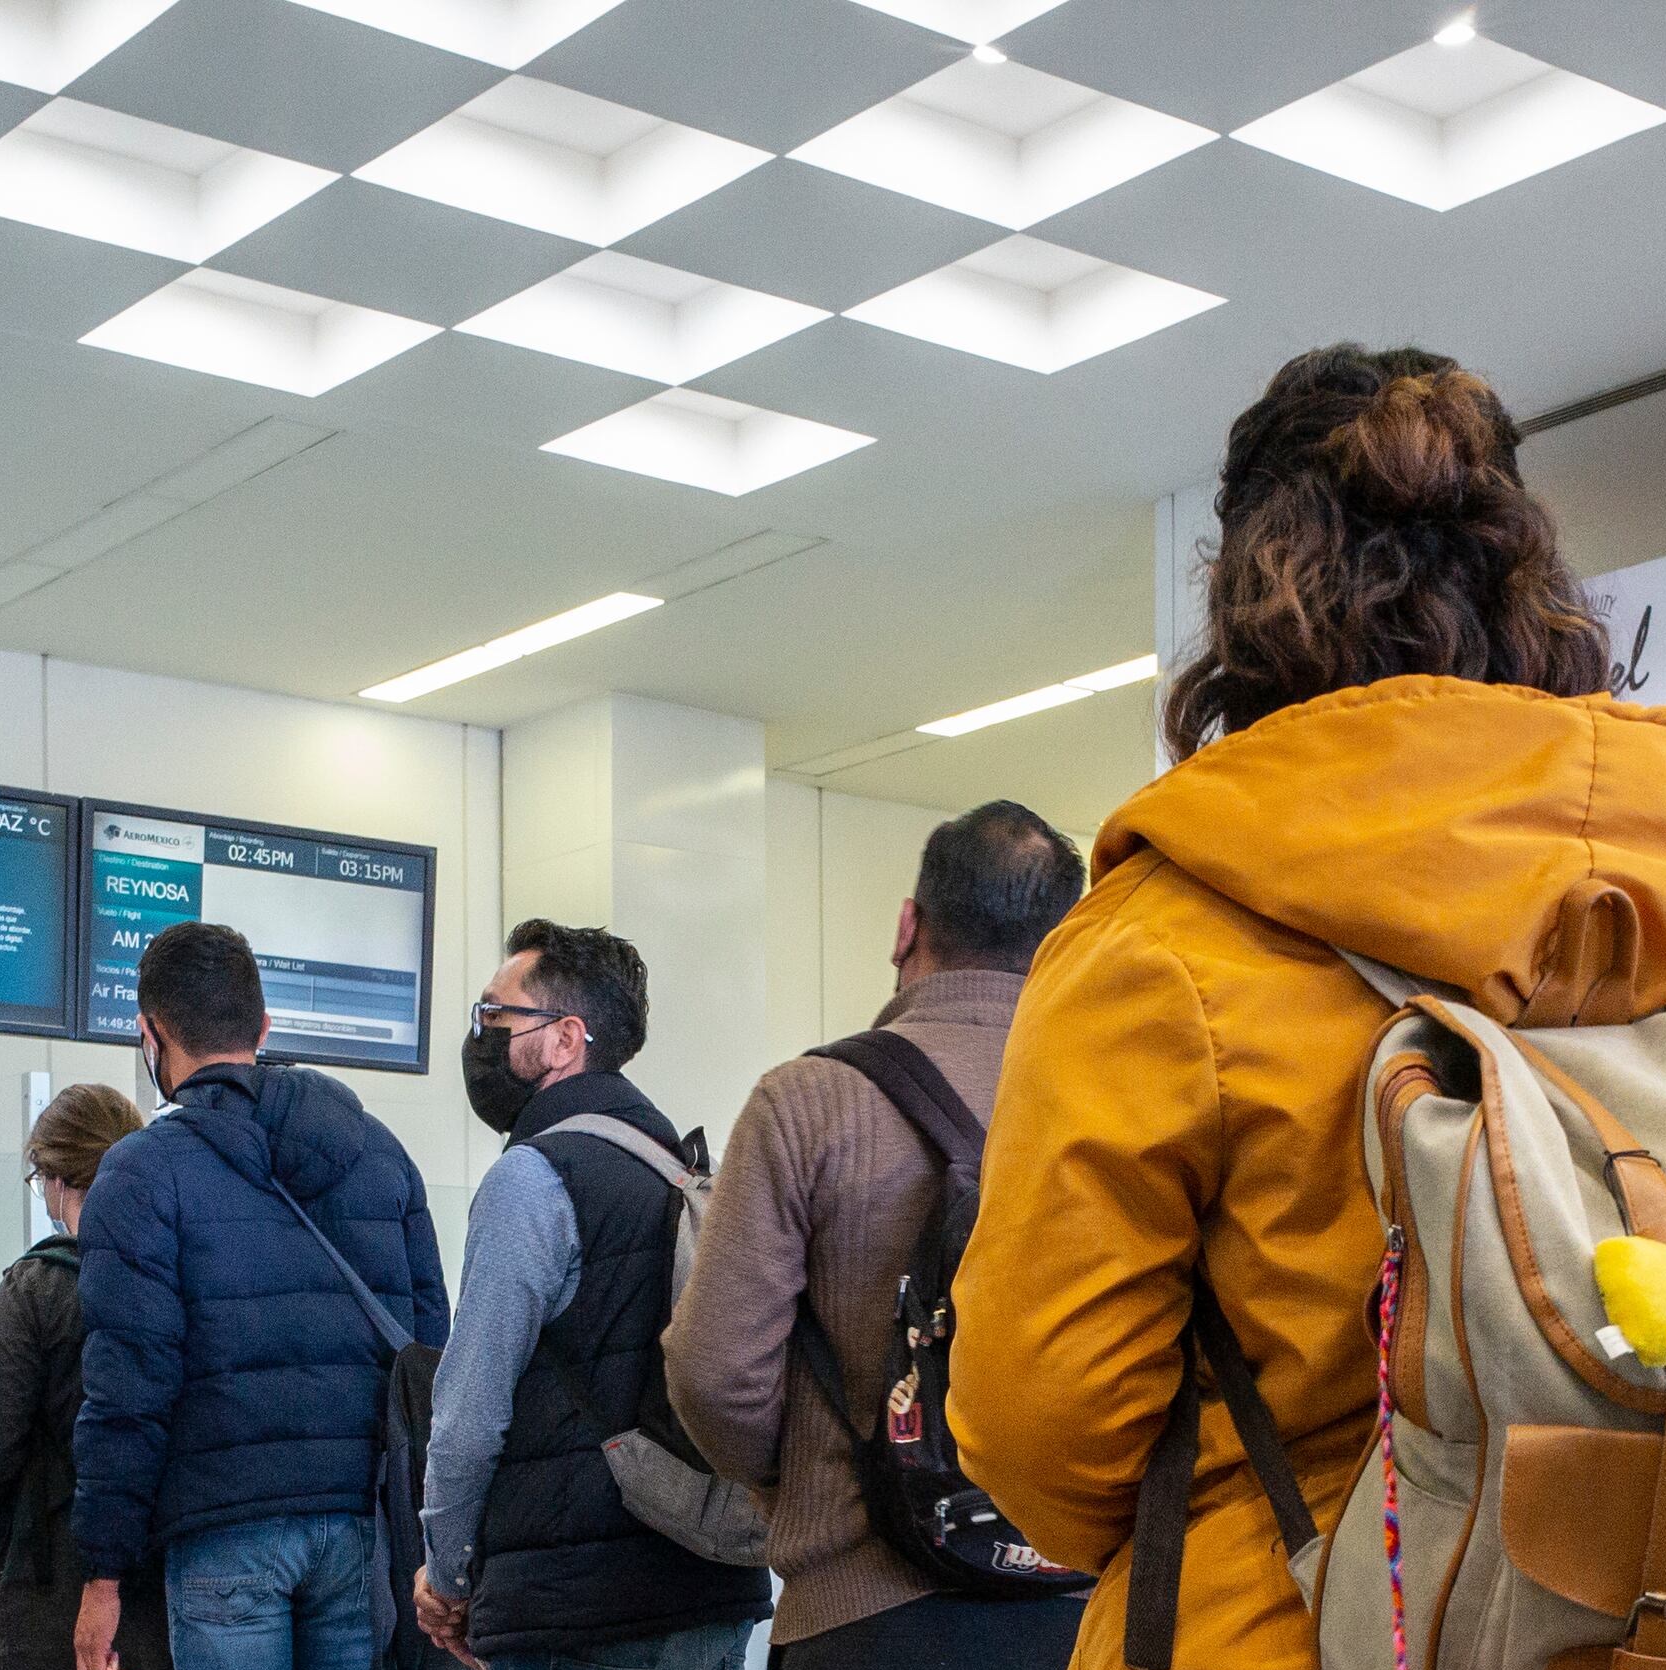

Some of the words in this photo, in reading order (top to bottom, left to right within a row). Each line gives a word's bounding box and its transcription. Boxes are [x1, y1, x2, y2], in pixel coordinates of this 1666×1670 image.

[30, 817, 51, 836] °C
[123, 830, 180, 846] AEROMEXICO
[228, 844, 294, 868] 02:45PM
[339, 860, 404, 883] 03:15PM
[106, 875, 189, 902] REYNOSA
[112, 929, 140, 949] AM
[92, 982, 111, 998] Air
